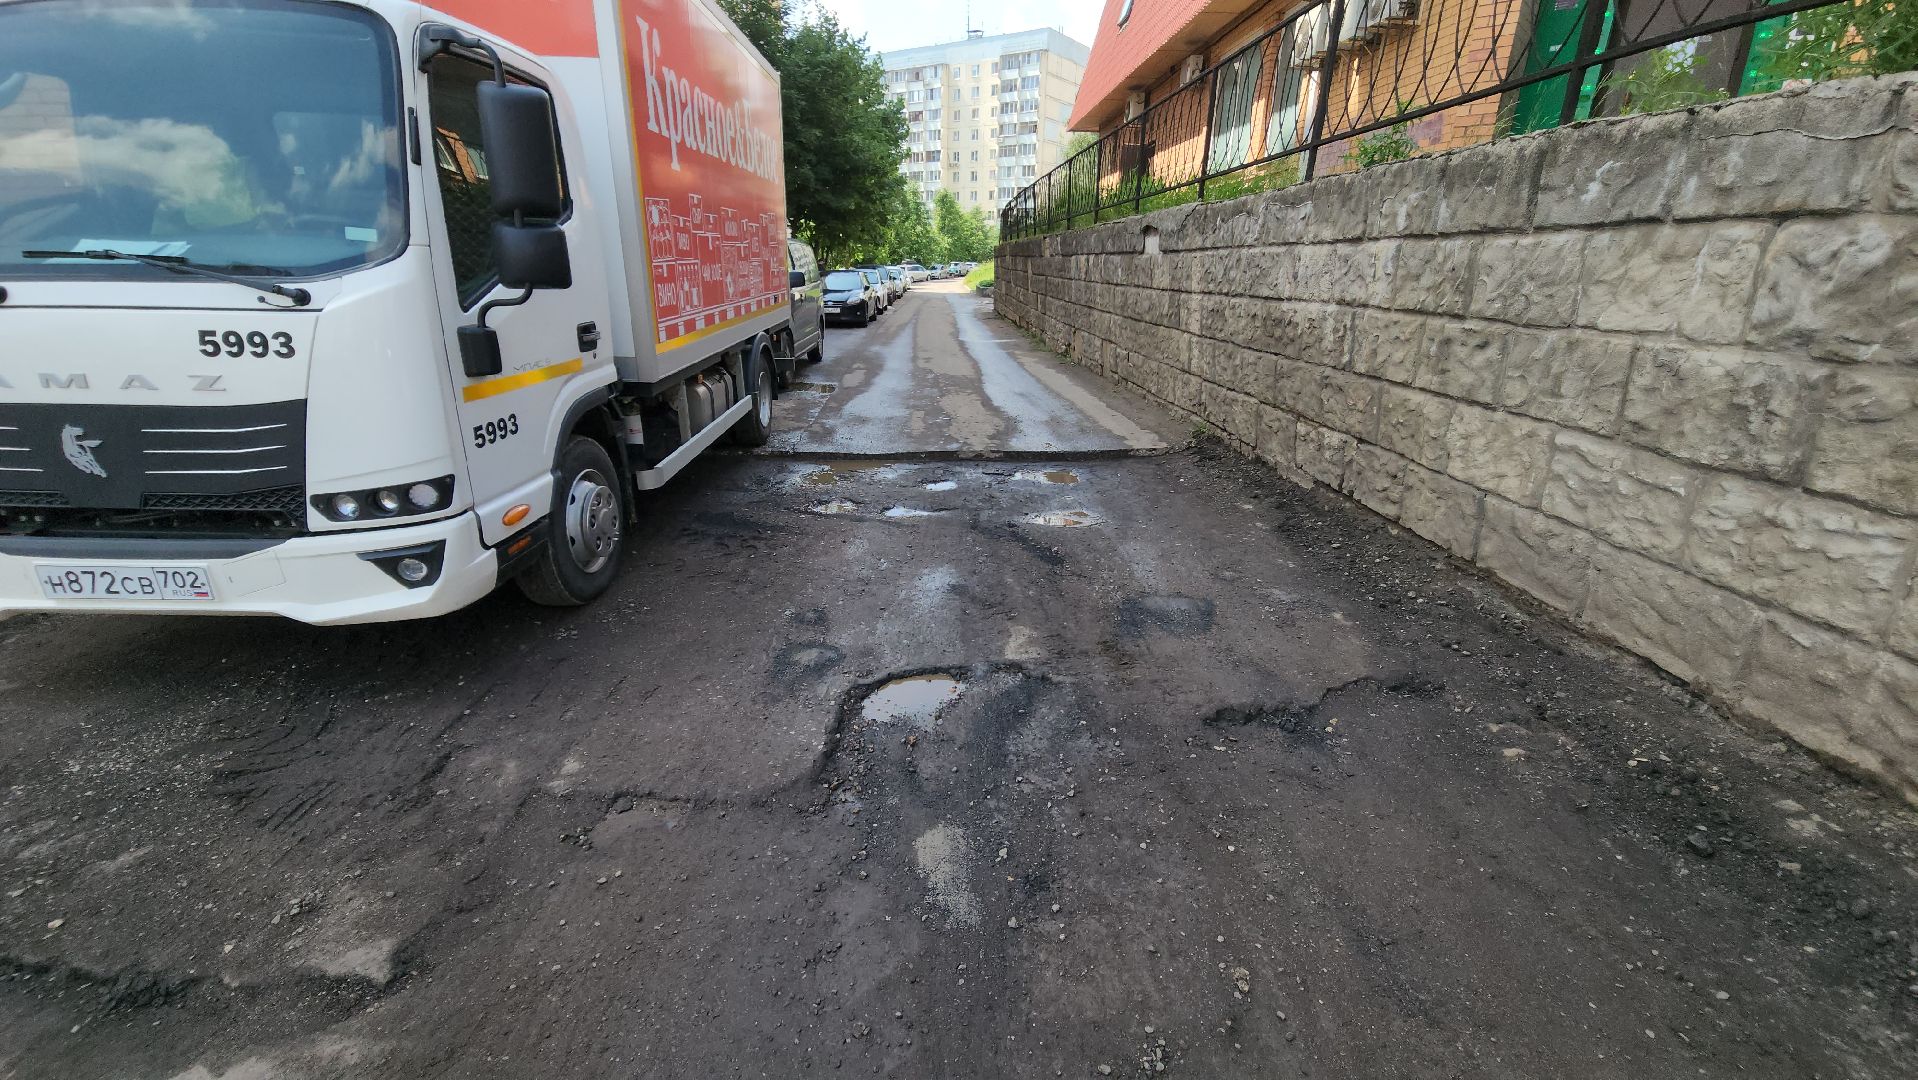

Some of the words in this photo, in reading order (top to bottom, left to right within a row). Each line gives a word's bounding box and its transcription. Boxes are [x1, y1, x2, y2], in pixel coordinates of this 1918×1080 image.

[657, 282, 677, 306] ВИНО
[197, 329, 296, 359] 5993
[472, 412, 519, 449] 5993
[172, 589, 193, 597] RUS
